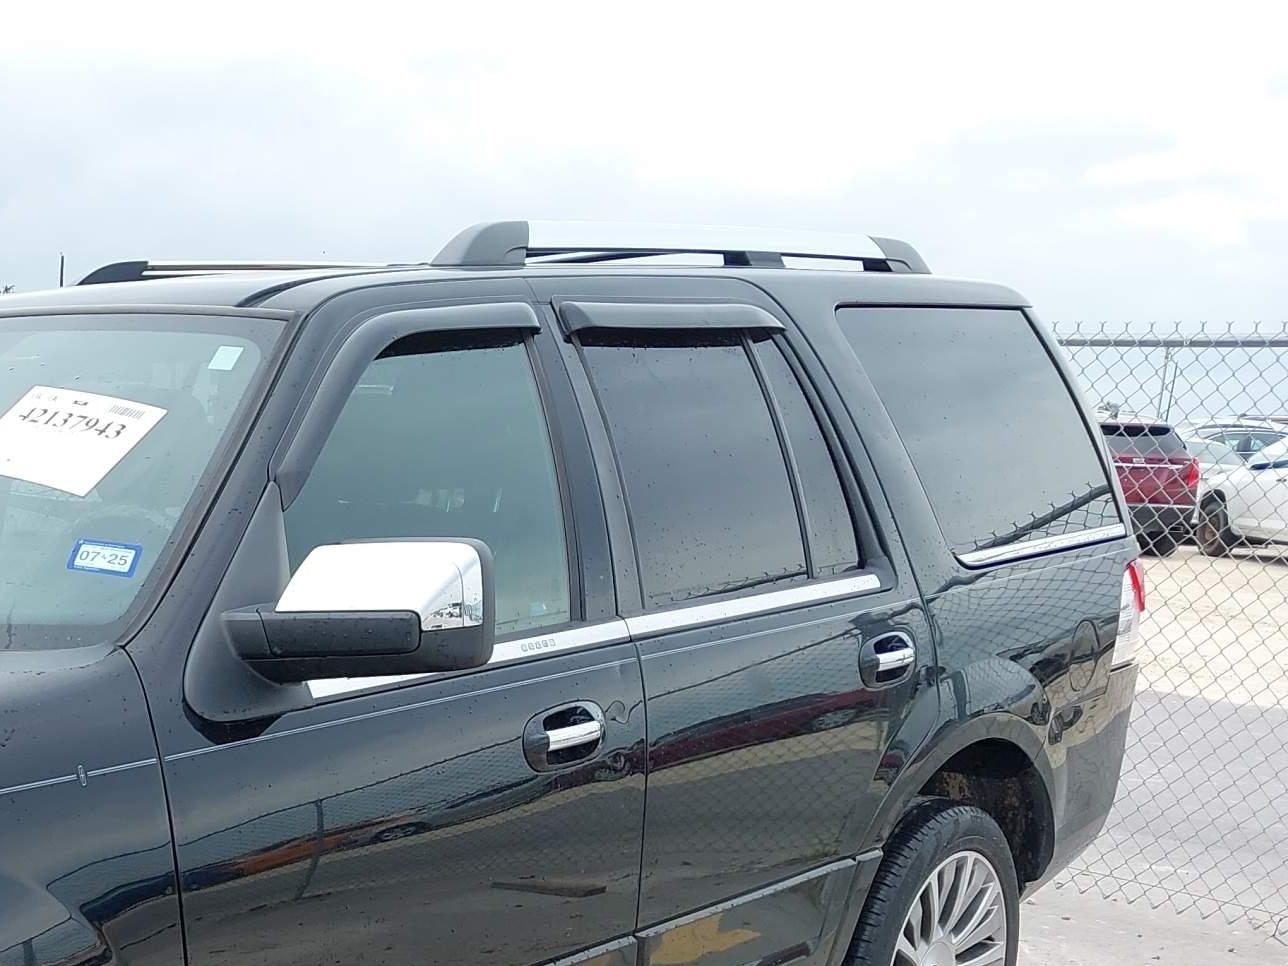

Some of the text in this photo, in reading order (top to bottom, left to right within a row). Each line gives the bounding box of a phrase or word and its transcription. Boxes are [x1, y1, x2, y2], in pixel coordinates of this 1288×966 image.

[18, 407, 127, 439] 42137943
[79, 550, 129, 566] 07 25
